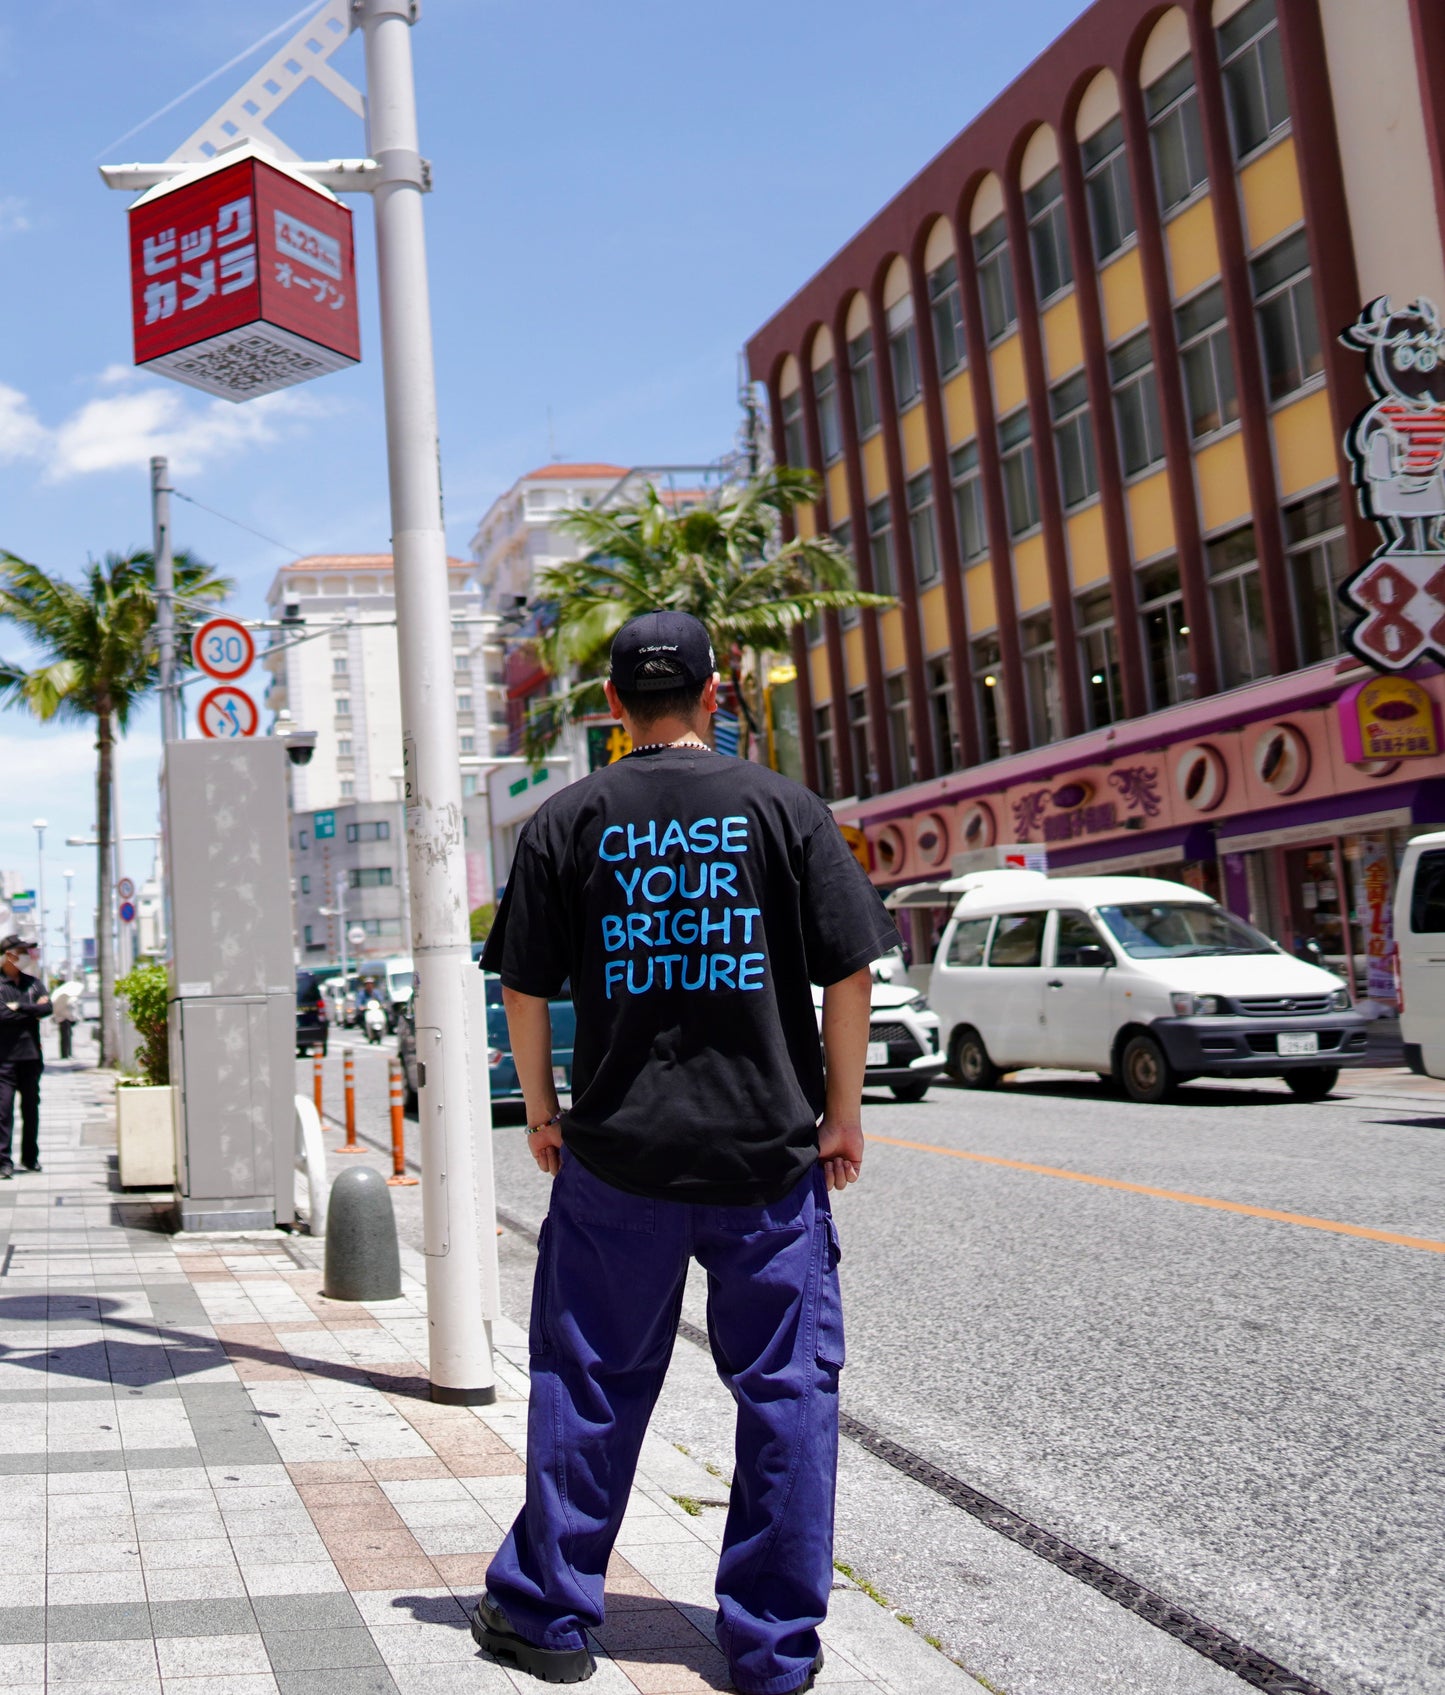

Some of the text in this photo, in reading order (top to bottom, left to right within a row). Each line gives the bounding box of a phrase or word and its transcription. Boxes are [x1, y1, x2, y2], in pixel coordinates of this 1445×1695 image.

[142, 195, 254, 276] ビック
[143, 243, 257, 325] カメラ
[273, 262, 345, 310] オープン
[208, 636, 242, 664] 30
[599, 816, 748, 862] CHASE
[614, 861, 738, 906] YOUR
[601, 907, 761, 952] BRIGHT
[604, 952, 765, 1000] FUTURE
